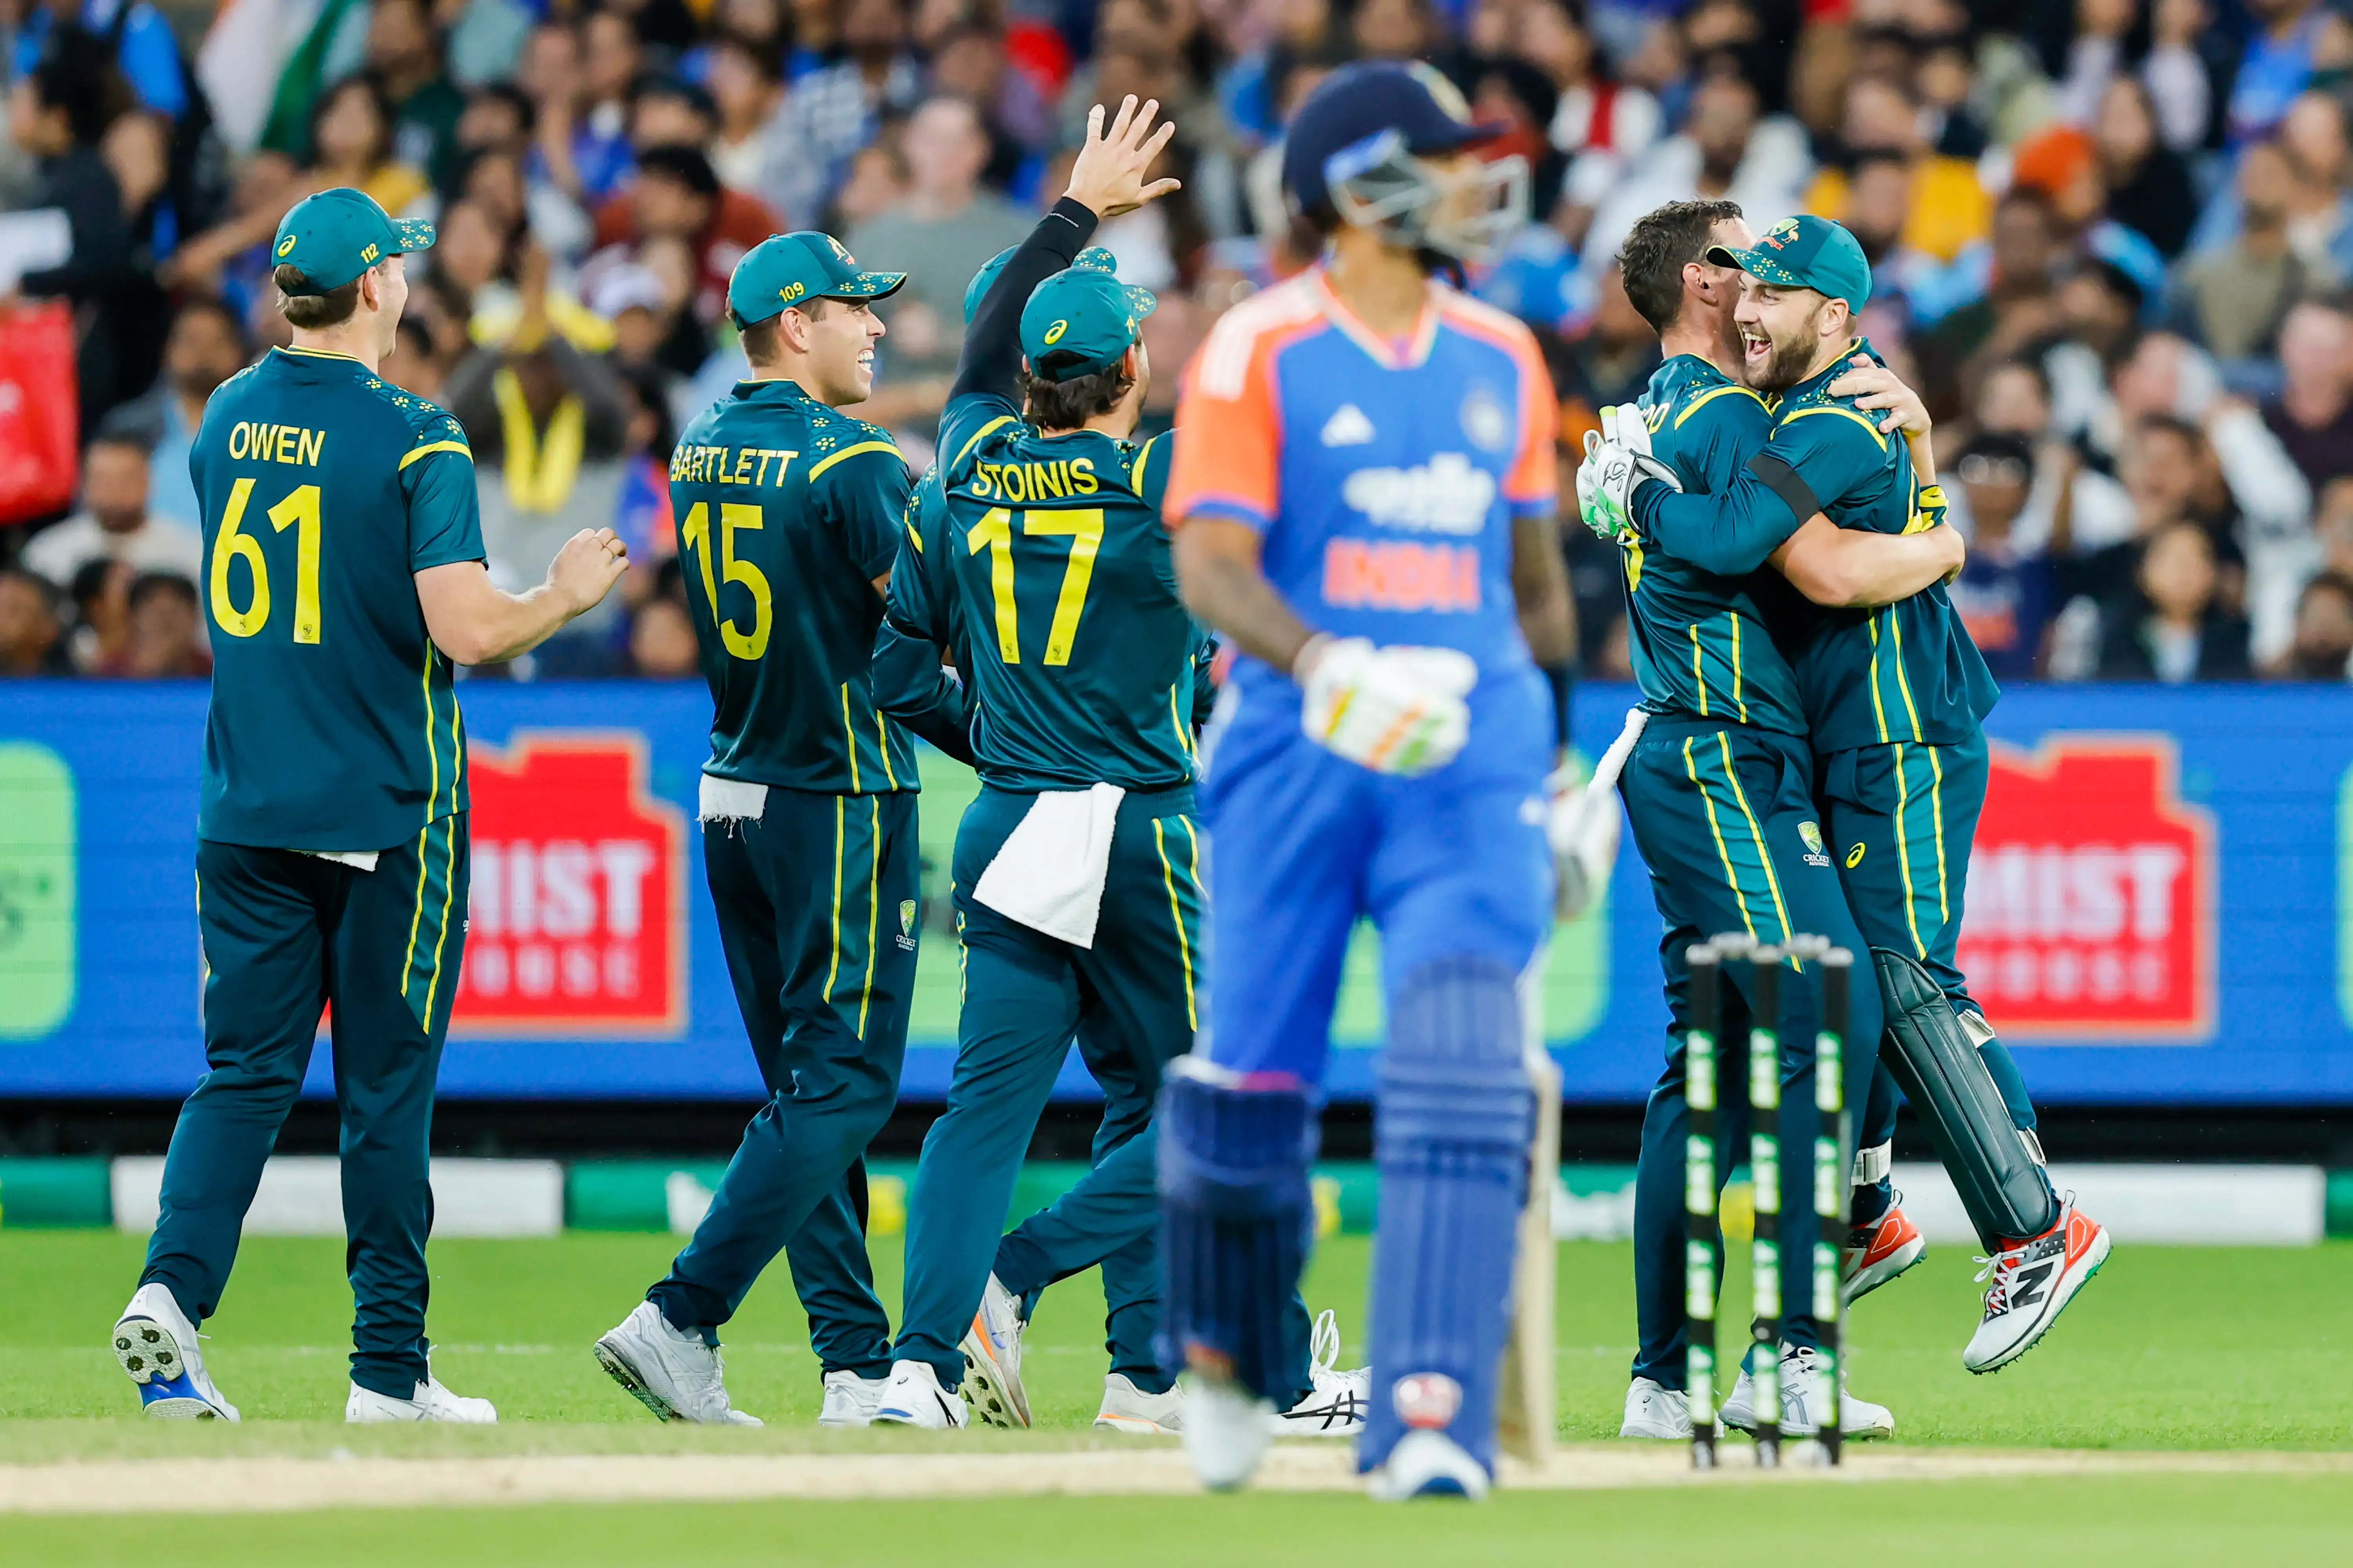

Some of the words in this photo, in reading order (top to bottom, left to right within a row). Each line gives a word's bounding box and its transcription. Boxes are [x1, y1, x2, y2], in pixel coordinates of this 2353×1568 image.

[361, 243, 380, 264] 112
[779, 282, 805, 303] 109
[229, 421, 325, 466] OWEN
[671, 445, 798, 487] BARTLETT
[971, 458, 1098, 502] STOINIS
[210, 478, 321, 644] 61
[682, 502, 773, 660] 15
[967, 507, 1104, 666] 17
[1803, 854, 1829, 864] CRICKET
[896, 934, 916, 947] CRICKET
[2011, 1261, 2054, 1310] N
